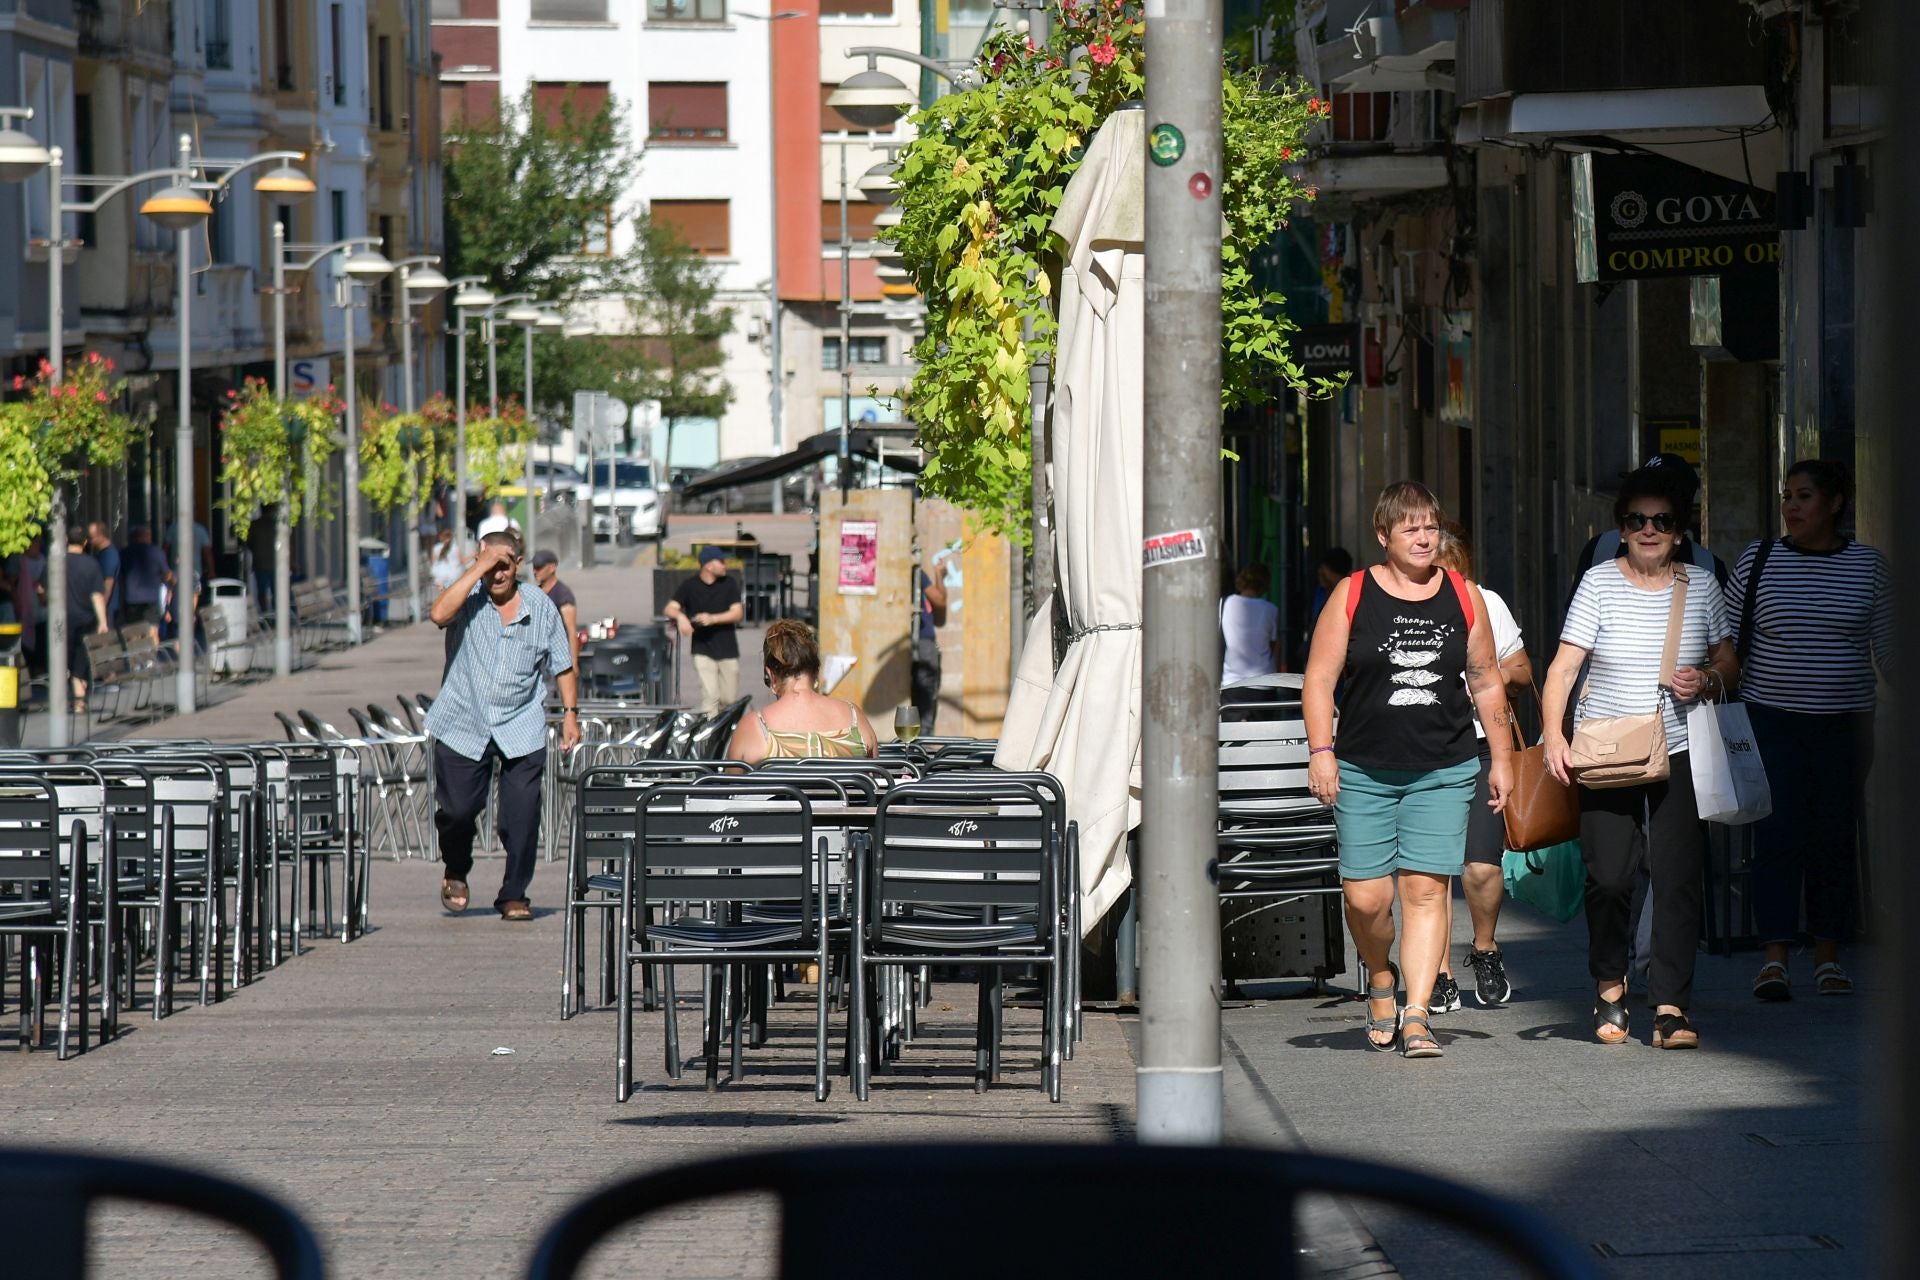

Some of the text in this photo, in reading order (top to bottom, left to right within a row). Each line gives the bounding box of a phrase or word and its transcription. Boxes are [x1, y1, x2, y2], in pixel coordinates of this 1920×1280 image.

[1655, 193, 1762, 225] GOYA
[1608, 245, 1734, 272] COMPRO
[1393, 615, 1434, 626] Stronger
[1395, 638, 1444, 649] yesterday
[708, 815, 740, 833] 18/70
[948, 819, 979, 836] 18/70
